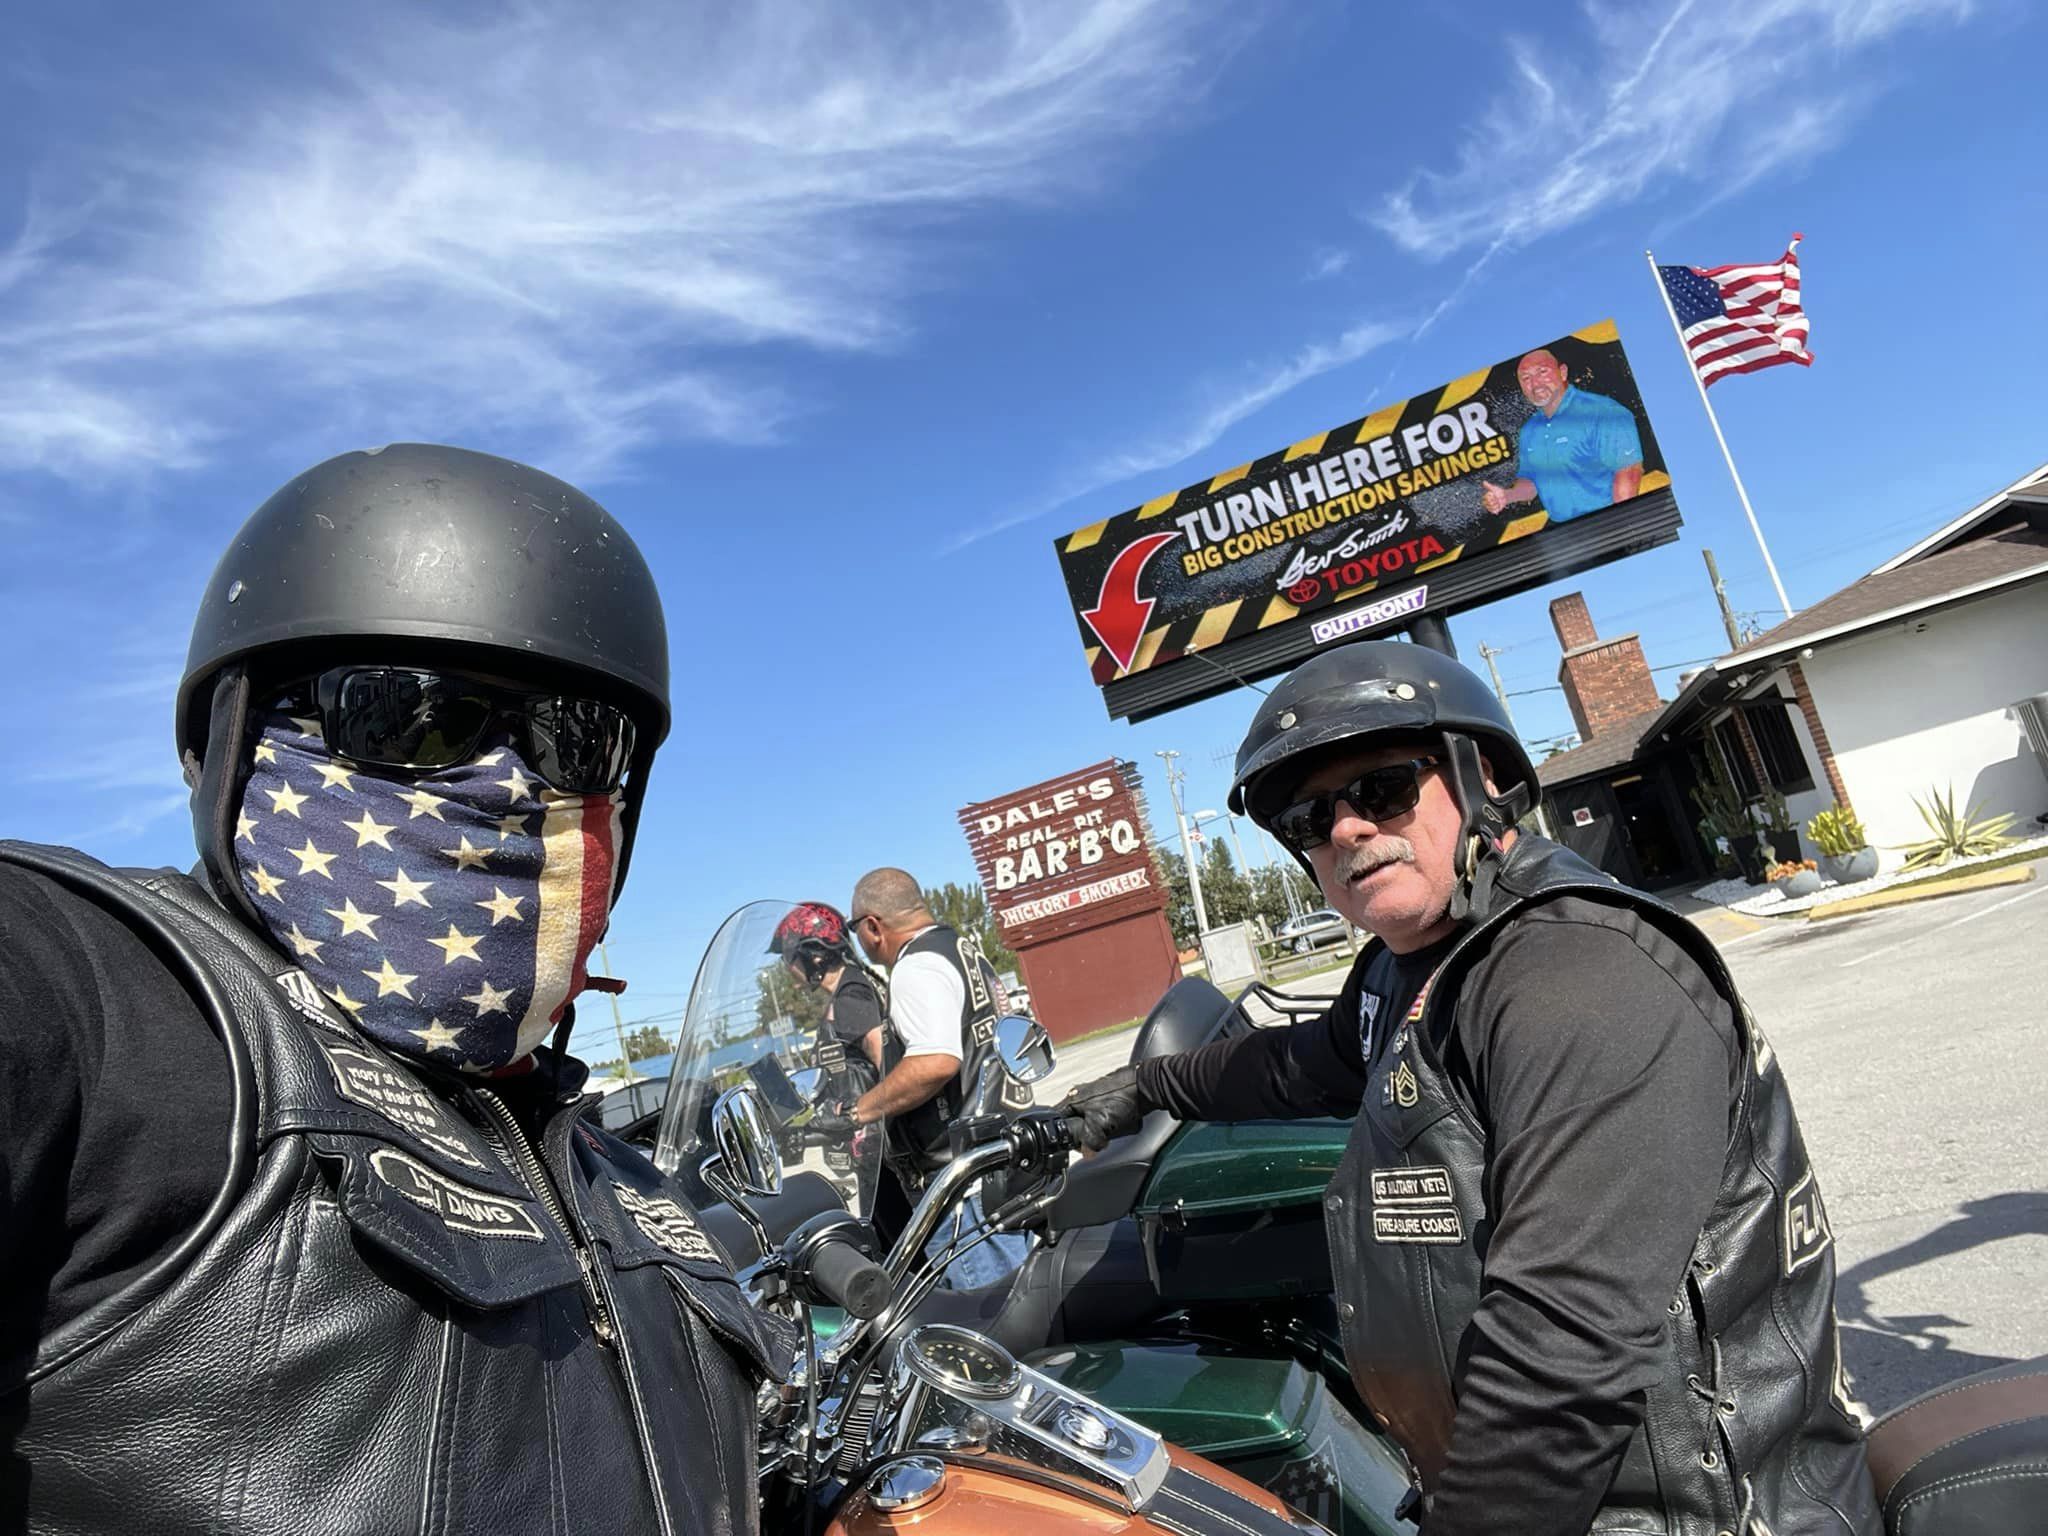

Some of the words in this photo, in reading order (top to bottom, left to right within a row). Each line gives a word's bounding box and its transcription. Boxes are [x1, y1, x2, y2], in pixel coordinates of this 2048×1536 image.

[1175, 479, 1289, 551] TURN
[1288, 436, 1402, 510] HERE
[1402, 401, 1499, 467] FOR
[1182, 545, 1223, 577] BIG
[1223, 479, 1397, 560] CONSTRUCTION
[1397, 436, 1511, 497] SAVINGS!
[1321, 534, 1445, 592] TOYOTA
[1316, 590, 1423, 640] OUTFRONT
[978, 777, 1115, 836] DALE'S
[1006, 825, 1059, 853] REAL
[1073, 808, 1104, 831] PIT
[1006, 892, 1071, 927] HICKORY
[1078, 871, 1142, 905] SMOKED
[446, 1191, 515, 1224] DAWG
[1420, 1177, 1446, 1193] VETS
[1375, 1218, 1422, 1233] TREASURE
[1421, 1218, 1456, 1233] COAST
